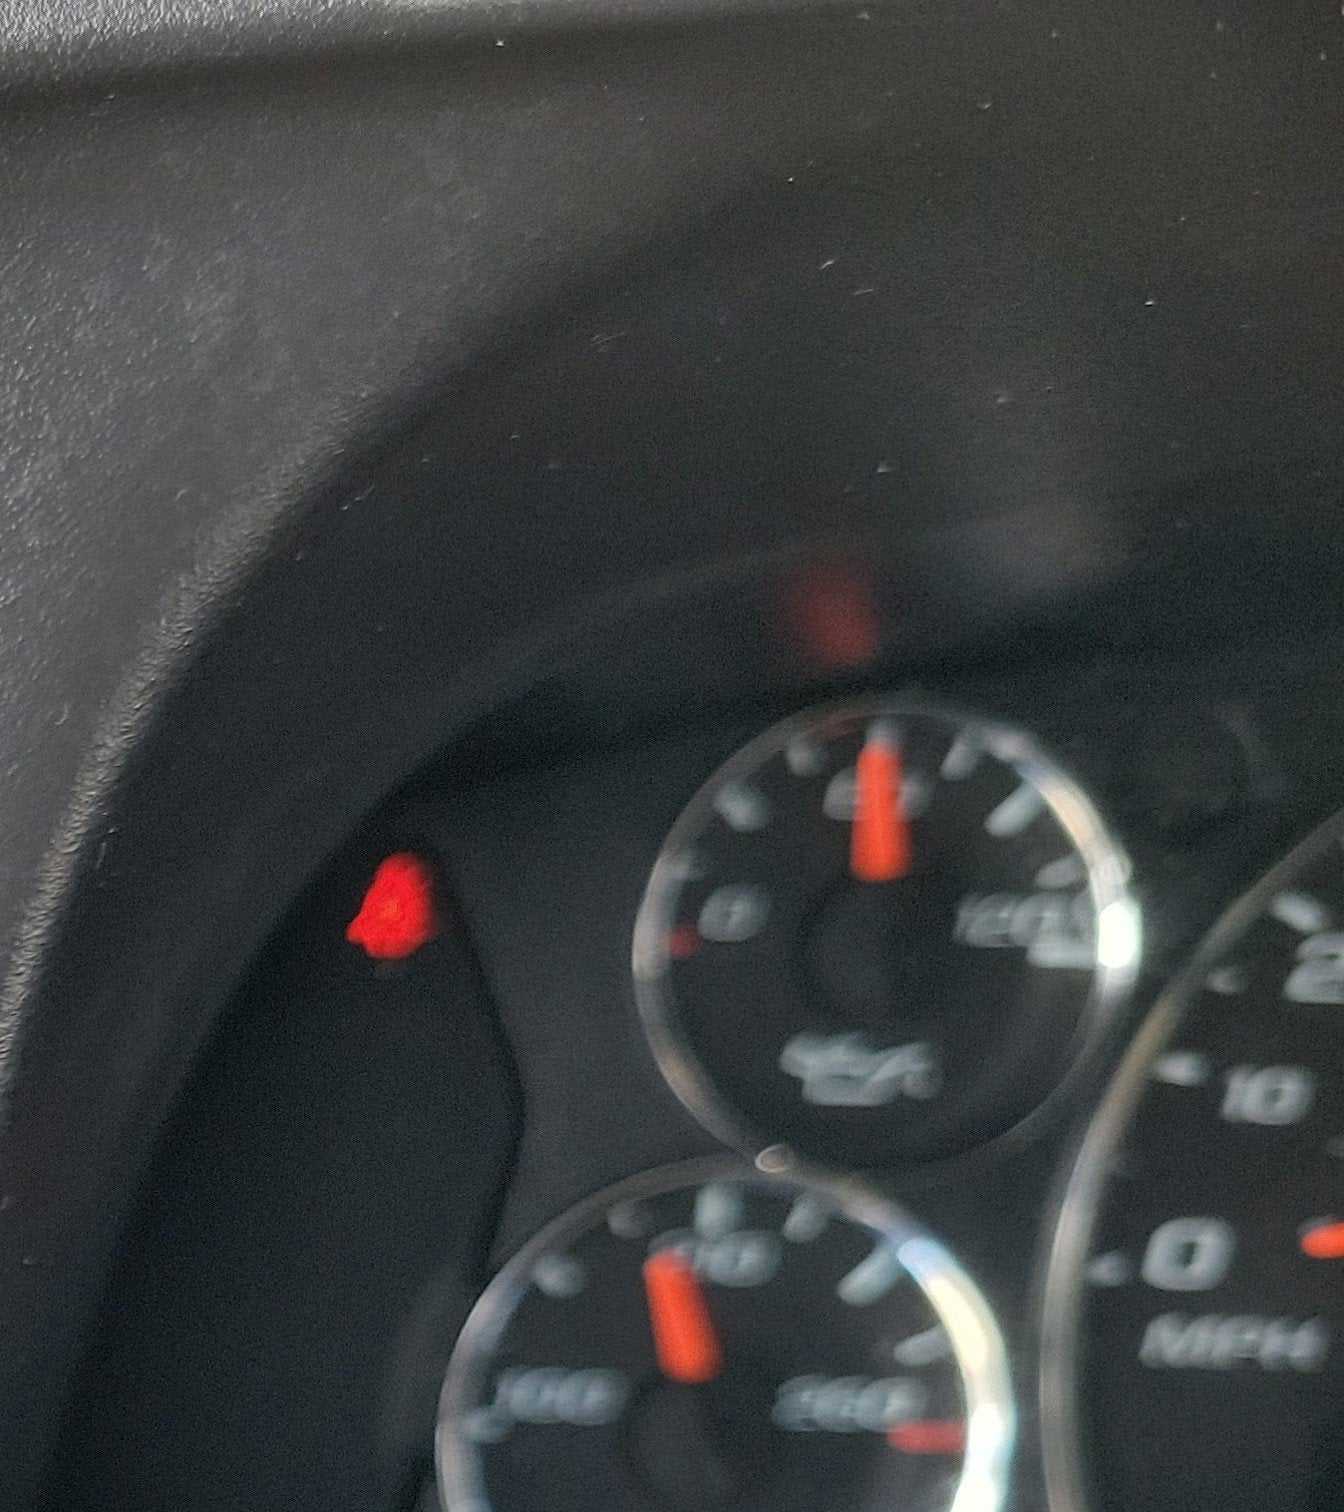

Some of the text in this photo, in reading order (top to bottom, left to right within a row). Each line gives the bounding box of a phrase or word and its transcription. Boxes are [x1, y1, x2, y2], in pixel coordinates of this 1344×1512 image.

[699, 880, 772, 942] 0
[1221, 1065, 1312, 1126] 10
[1141, 1216, 1234, 1292] 0
[1139, 1311, 1328, 1371] MPH
